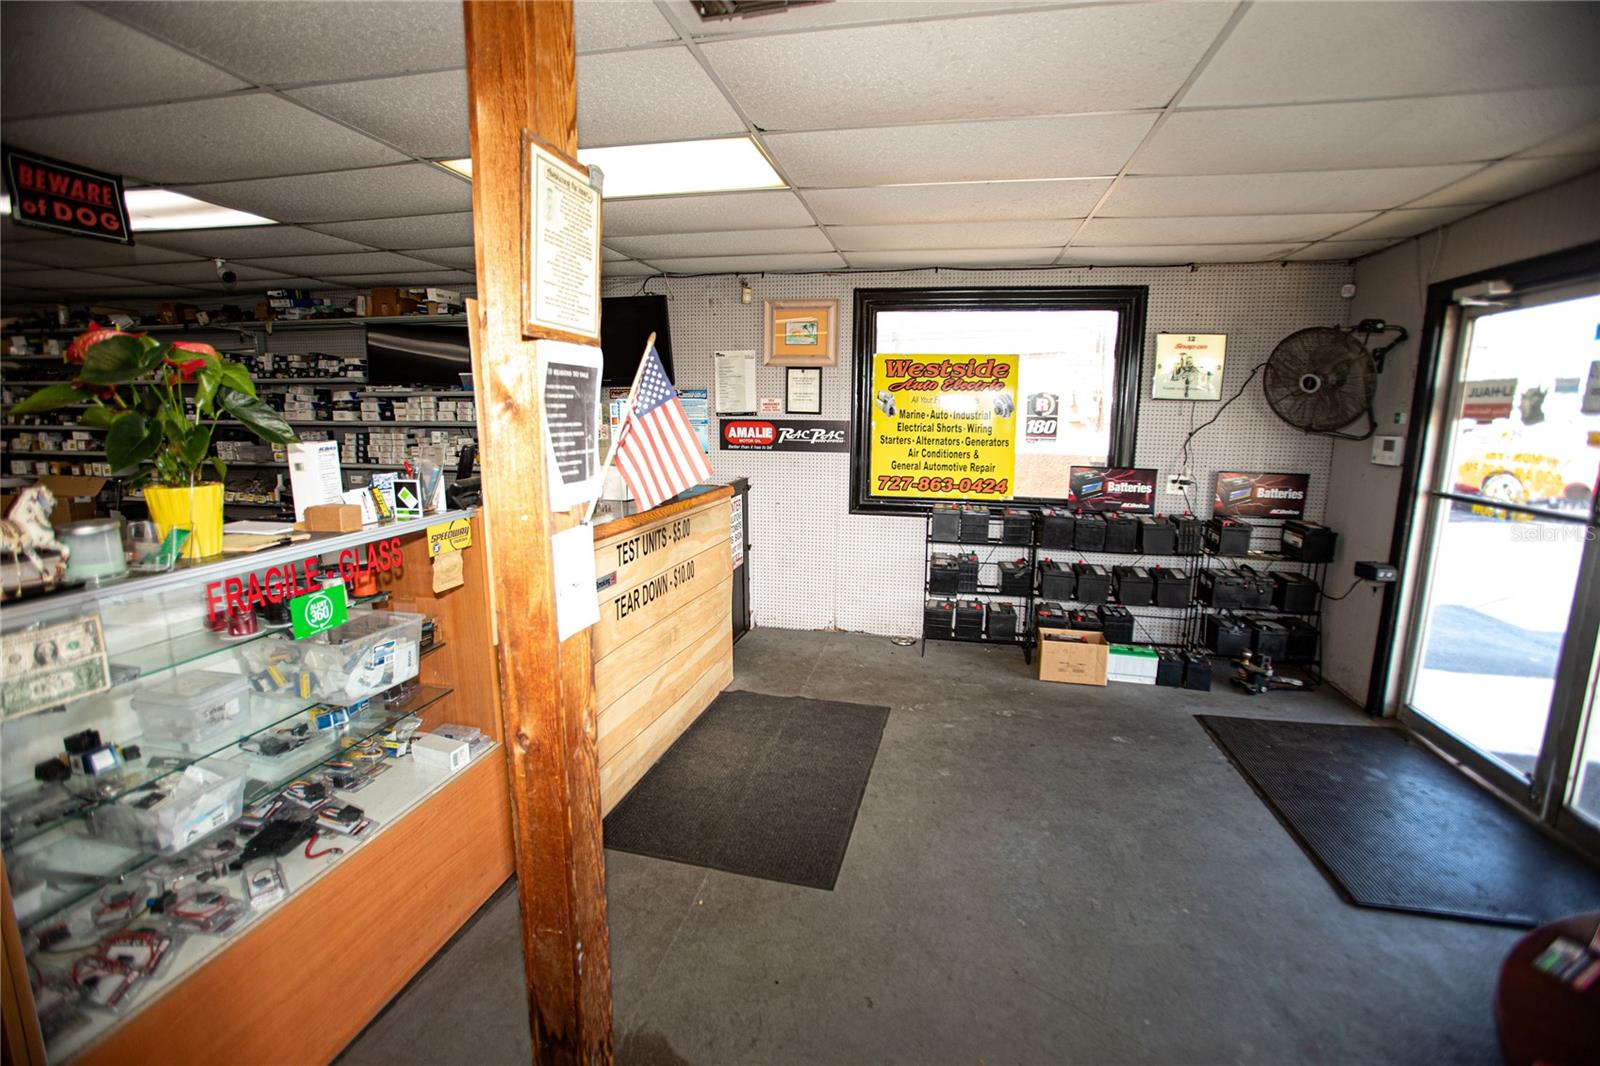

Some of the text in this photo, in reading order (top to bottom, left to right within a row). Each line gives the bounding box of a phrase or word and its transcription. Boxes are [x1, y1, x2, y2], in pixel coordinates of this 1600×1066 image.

[18, 163, 114, 208] BEWARE
[21, 196, 120, 231] of DOG
[885, 358, 1011, 379] Westside
[888, 378, 1006, 392] Auto Electric
[899, 409, 992, 421] Marine Auto Industrial
[728, 426, 773, 438] AMALIE
[897, 422, 993, 435] Electrical Shorts Wiring
[1026, 419, 1057, 434] 180
[880, 435, 1010, 447] Starters Alternators Generators
[908, 448, 979, 459] Air Conditioners &
[891, 460, 996, 474] General Automotive Repair
[878, 475, 1008, 494] 727-863-0424
[1107, 481, 1152, 493] Batteries
[1257, 487, 1304, 499] Batteries
[431, 526, 470, 543] SPEEDWAY
[617, 537, 640, 567] TEST
[643, 527, 667, 555] UNITS
[673, 518, 691, 543] $5.00
[205, 536, 404, 622] FRAGILE GLASS
[615, 588, 640, 620] TEAR
[642, 574, 668, 606] DOWN
[674, 560, 695, 588] $10.00
[310, 606, 329, 623] 360
